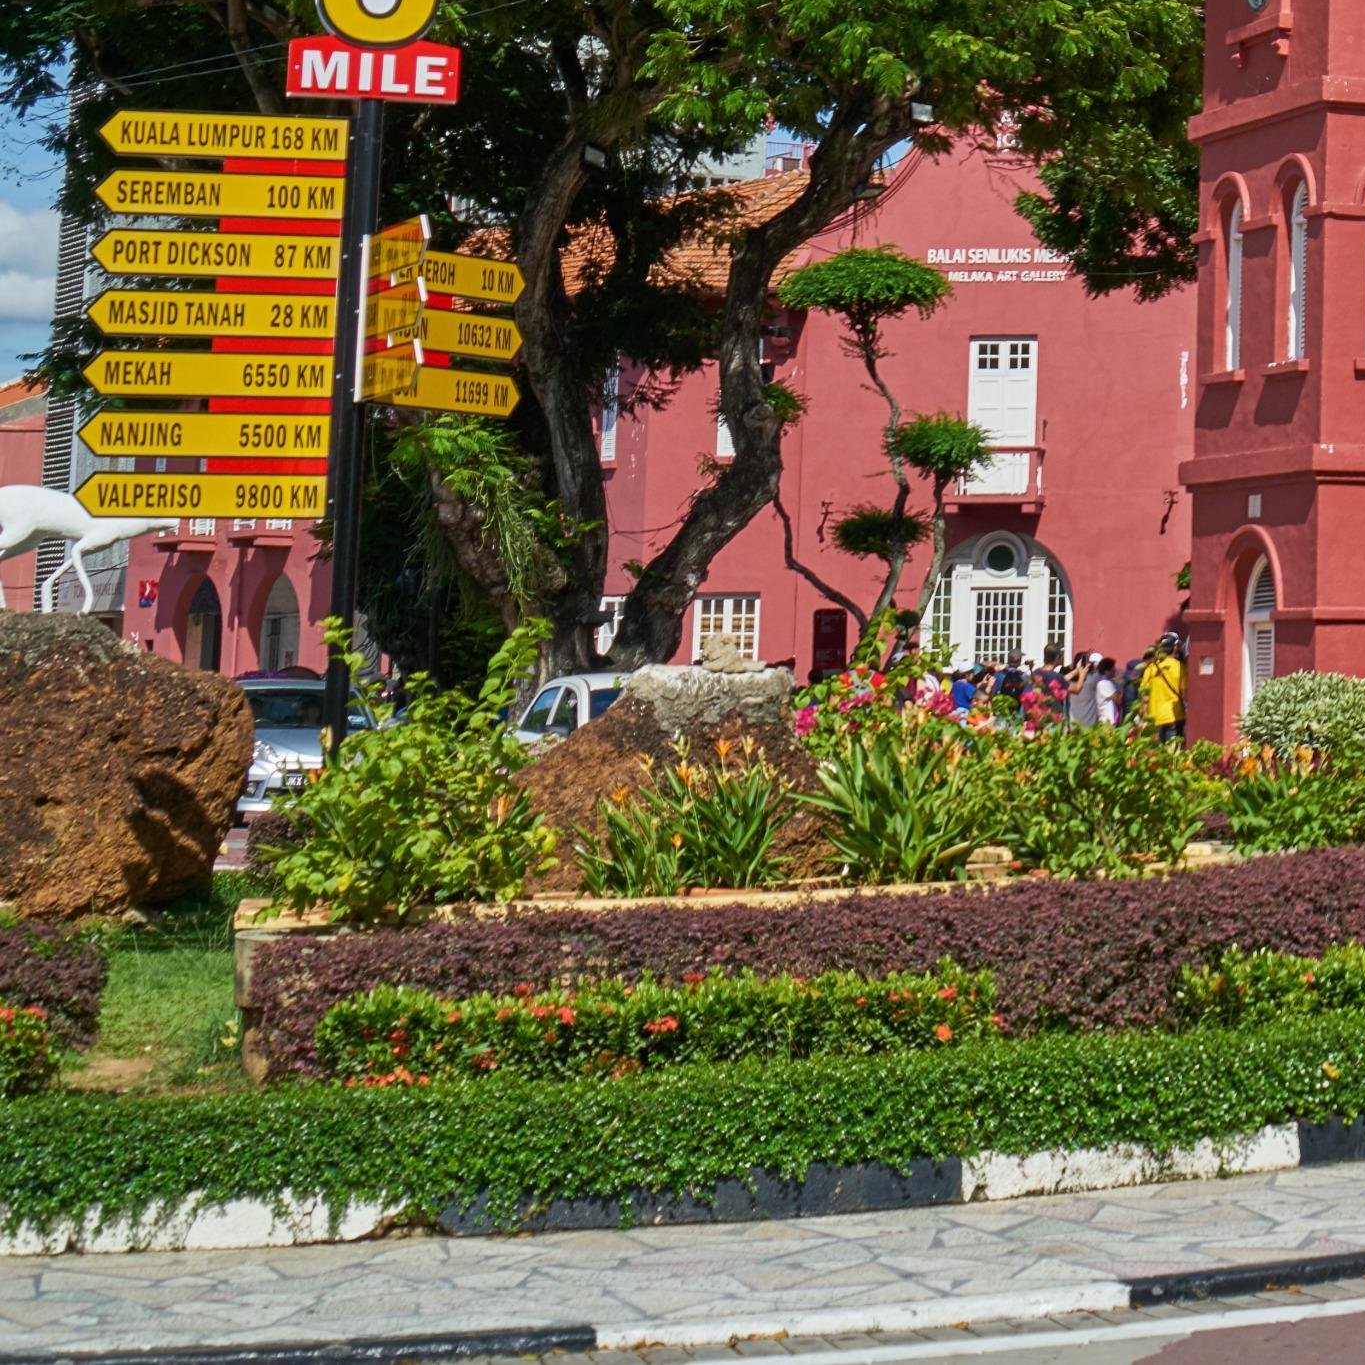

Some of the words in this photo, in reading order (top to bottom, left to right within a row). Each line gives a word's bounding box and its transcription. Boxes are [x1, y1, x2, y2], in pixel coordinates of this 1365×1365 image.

[300, 49, 448, 96] MILE
[121, 120, 180, 146] KUALA
[187, 122, 266, 149] LUMPUR
[271, 126, 304, 150] 168
[311, 127, 338, 152] KM
[116, 179, 221, 207] SEREMBAN
[267, 185, 300, 209] 100
[307, 186, 336, 210] KM
[113, 239, 162, 264] PORT
[168, 241, 251, 267] DICKSON
[274, 245, 297, 268] 87
[303, 246, 331, 269] KM
[927, 248, 966, 264] BALAI
[417, 259, 455, 286] KEROH
[481, 269, 494, 291] 10
[498, 271, 514, 294] KM
[948, 271, 993, 282] MELAKA
[996, 271, 1018, 282] ART
[1021, 271, 1067, 282] GALLERY
[108, 300, 178, 326] MASJID
[185, 302, 245, 327] TANAH
[270, 304, 293, 328] 28
[300, 305, 328, 329] KM
[457, 322, 491, 348] 10632
[495, 326, 512, 350] KM
[104, 360, 171, 385] MEKAH
[243, 364, 290, 388] 6550
[297, 364, 325, 389] KM
[454, 379, 488, 406] 11699
[493, 385, 508, 407] KM
[100, 422, 182, 448] NANJING
[239, 424, 287, 449] 5500
[294, 424, 322, 449] KM
[98, 484, 201, 509] VALPERISO
[235, 484, 283, 509] 9800
[290, 485, 318, 509] KM
